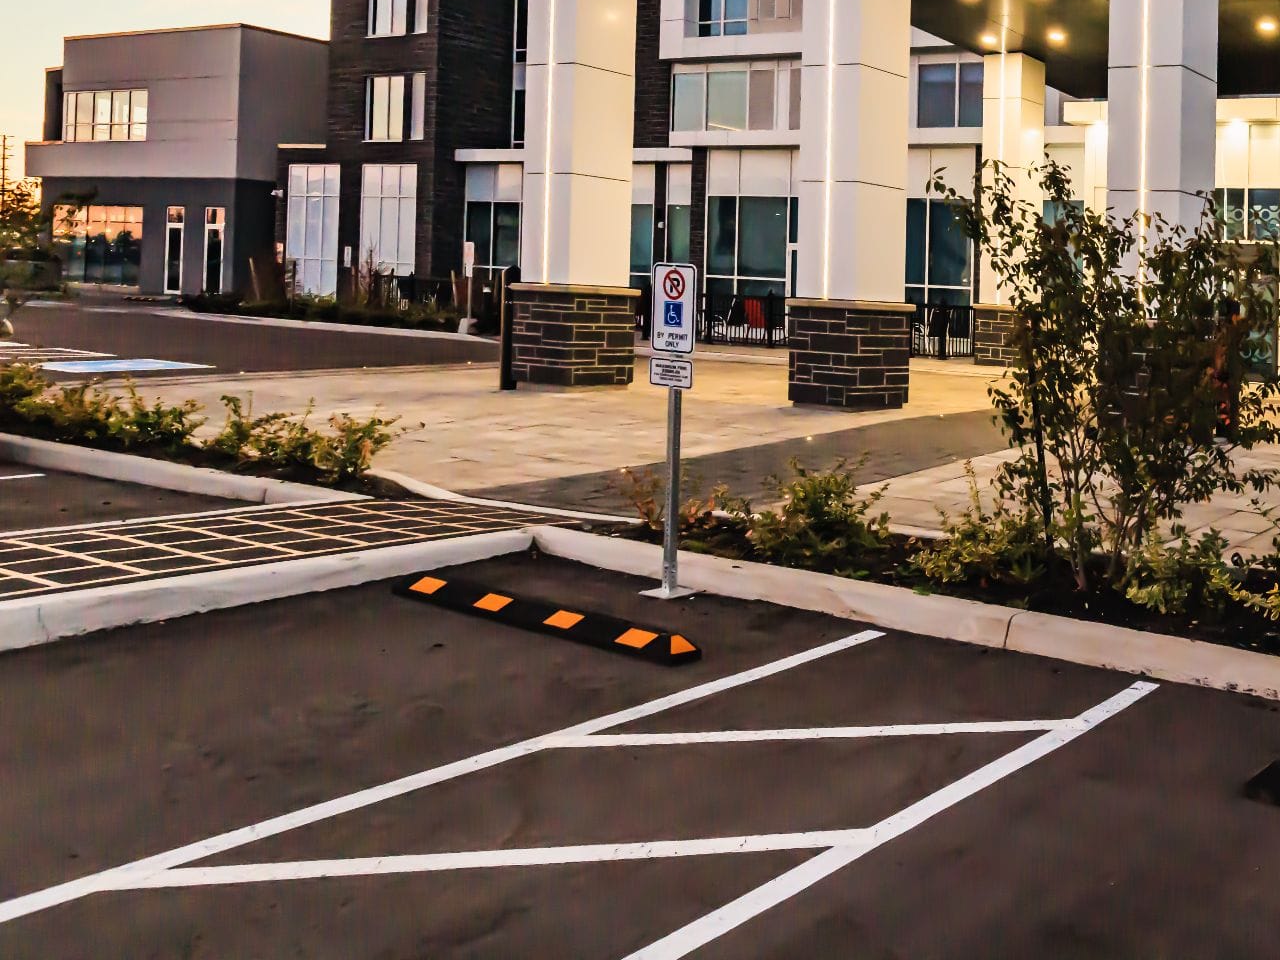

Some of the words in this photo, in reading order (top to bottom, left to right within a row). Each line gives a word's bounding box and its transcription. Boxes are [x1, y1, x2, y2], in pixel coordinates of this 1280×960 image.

[656, 331, 665, 339] BY
[667, 332, 688, 341] PERMIT
[665, 340, 680, 348] ONLY
